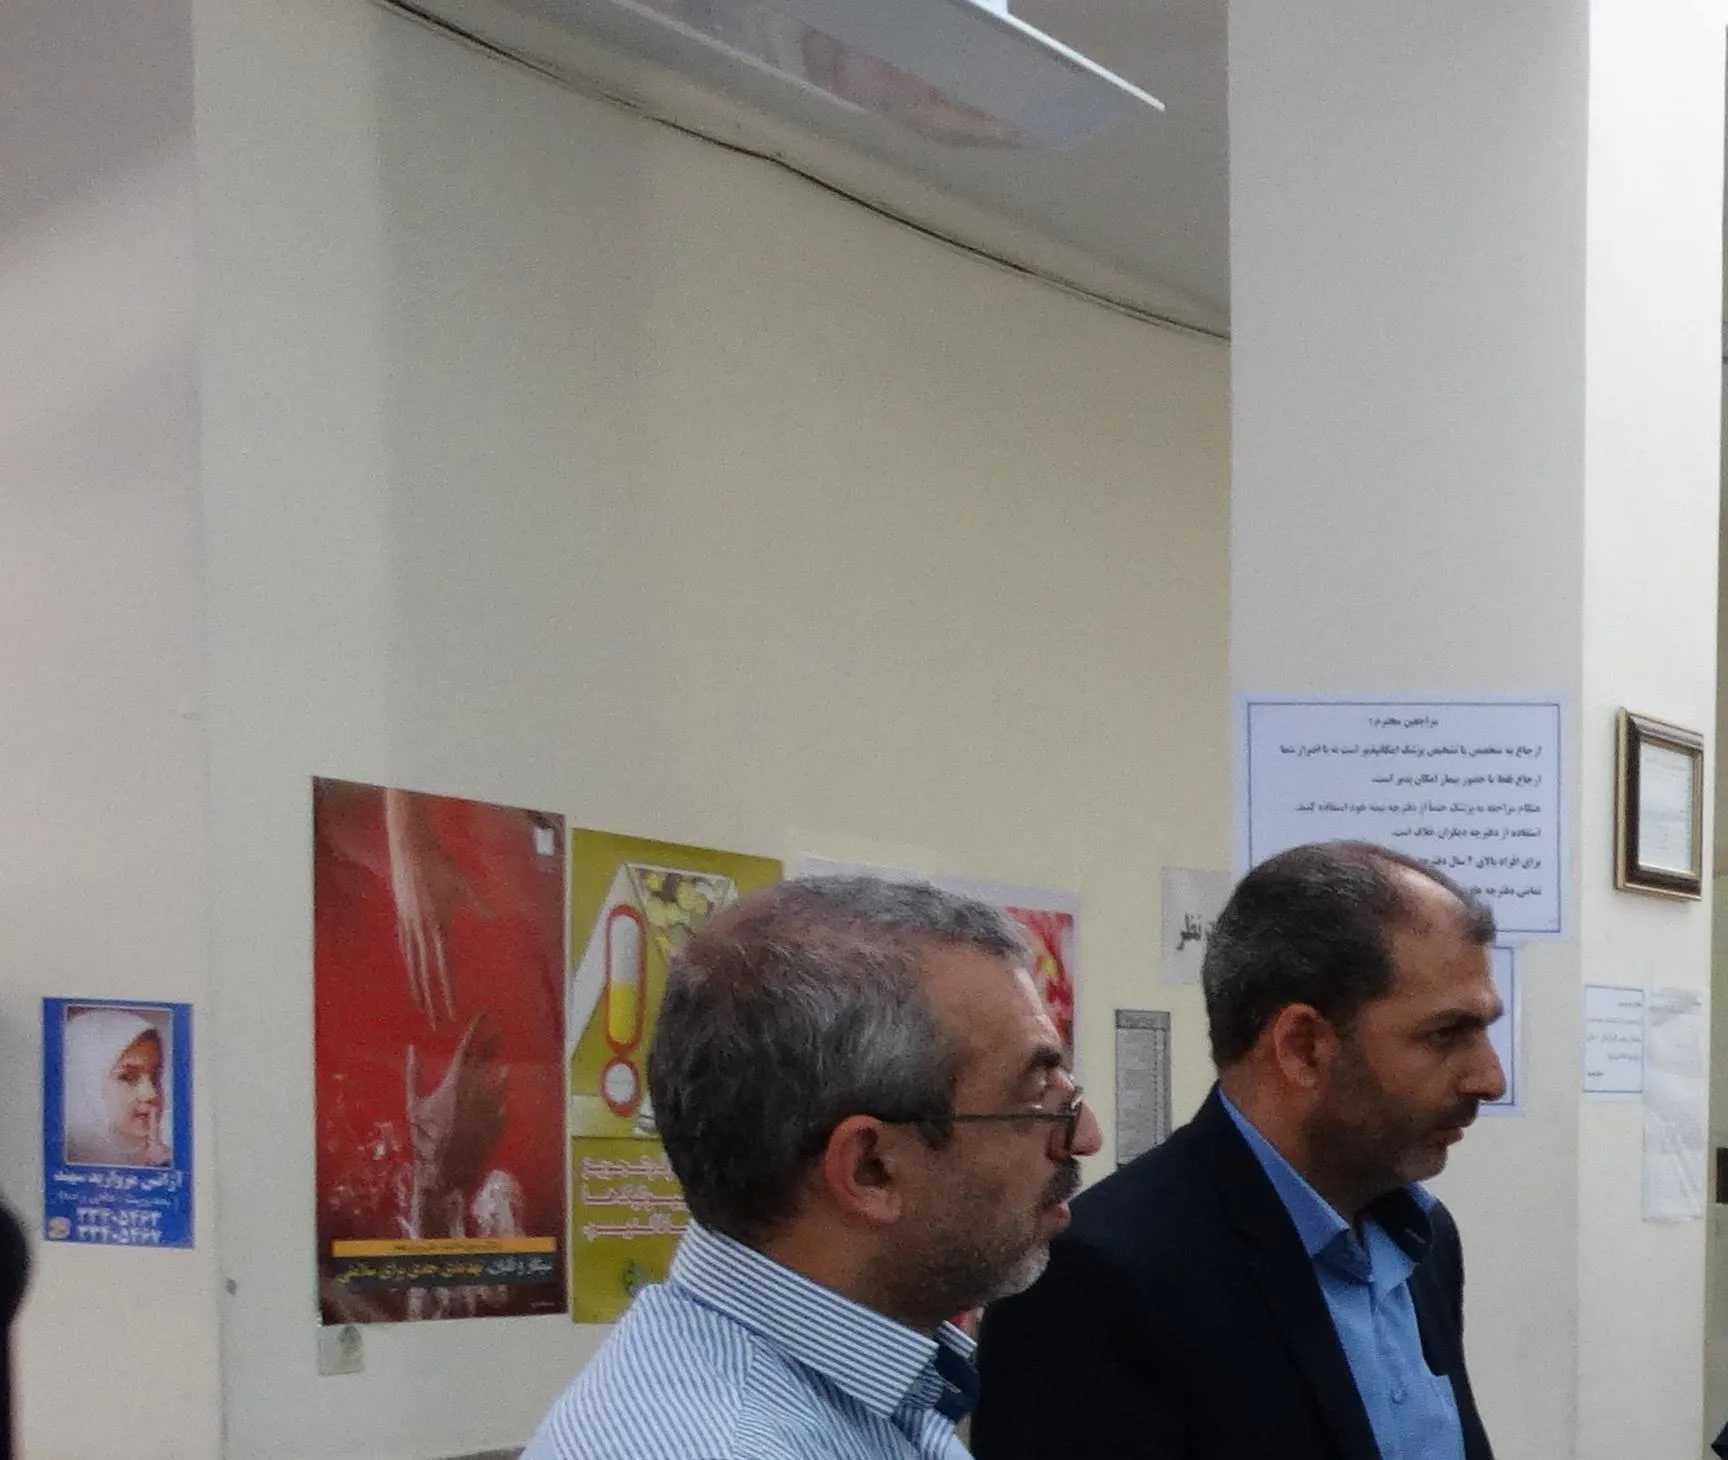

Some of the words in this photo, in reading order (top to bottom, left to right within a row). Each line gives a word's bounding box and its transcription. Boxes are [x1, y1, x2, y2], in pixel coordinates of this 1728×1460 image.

[1516, 773, 1542, 787] ارجاع
[1511, 826, 1541, 837] استفاده
[1476, 856, 1496, 869] بالای
[1499, 856, 1519, 869] افراد
[1522, 856, 1541, 869] برای
